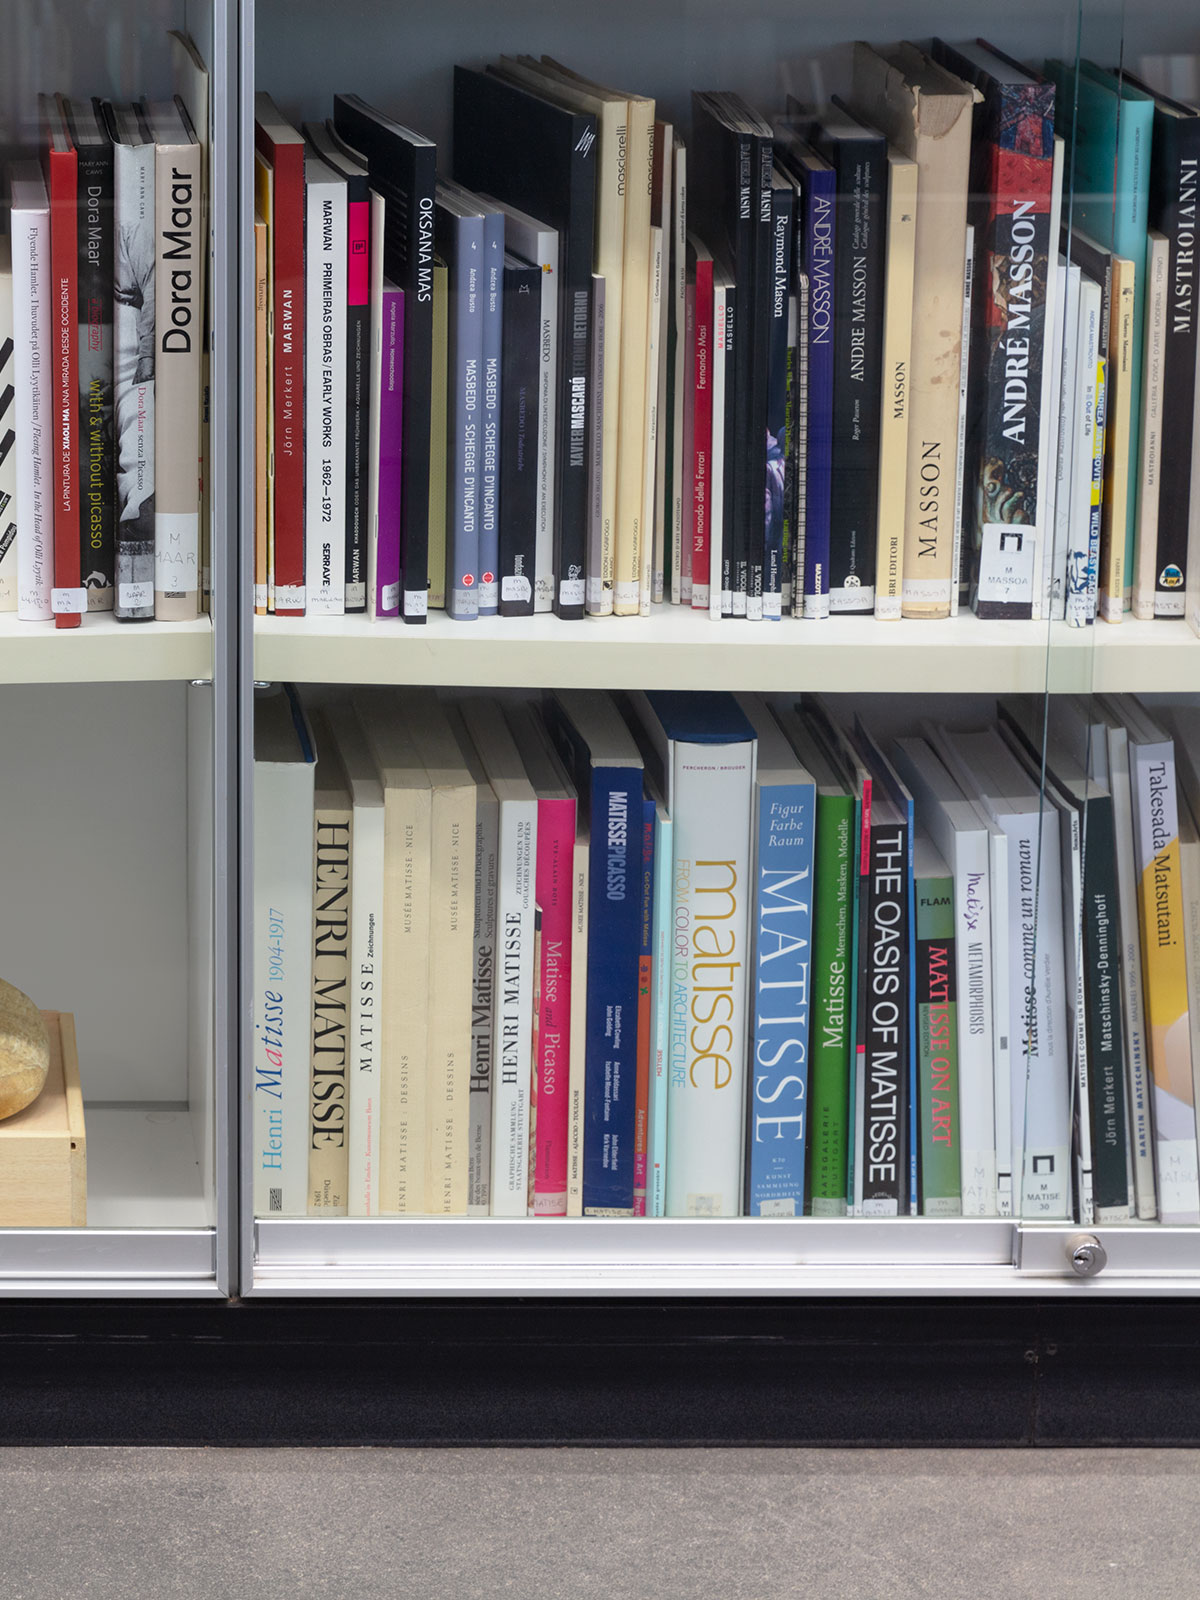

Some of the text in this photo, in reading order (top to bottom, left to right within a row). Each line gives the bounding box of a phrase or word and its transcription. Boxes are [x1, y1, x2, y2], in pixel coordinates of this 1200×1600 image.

[87, 186, 102, 265] Dora Maar
[163, 168, 191, 353] Dora Maar
[322, 262, 332, 323] PRIMEIRAS
[323, 200, 332, 251] MARWAN
[418, 198, 433, 301] OKSANA MAS
[469, 268, 477, 291] Andrea
[775, 215, 788, 318] Raymond Mason
[813, 197, 832, 344] ANDRÉ MASSON
[1174, 159, 1197, 333] MASTROIANNI
[282, 290, 292, 456] Jörn Merkert MARWAN
[322, 325, 332, 362] OBRAS
[322, 370, 332, 404] EARLY
[465, 360, 476, 410] MASBEDO
[851, 256, 867, 381] ANDRE MASSON
[894, 362, 905, 419] MASSON
[1000, 200, 1036, 445] ANDRÉ MASSON
[61, 278, 71, 511] LA PINTURA DE XIAOLI MA UNA MIRADA DESDE OCCIDENTE
[86, 380, 104, 549] with & without picasso
[137, 387, 146, 409] Dora
[137, 411, 146, 433] Maar
[322, 406, 332, 447] WORKS
[464, 424, 475, 473] SCHEGGE
[137, 460, 146, 490] Picasso
[464, 477, 475, 532] D'INCANTO
[918, 441, 941, 558] MASSON
[768, 835, 804, 847] Raum
[770, 803, 804, 817] Figur
[770, 818, 803, 831] Farbe
[1149, 762, 1177, 947] Takesada Matsutani
[312, 820, 349, 1150] HENRI MATISSE
[360, 913, 375, 1073] MATISSE Zeichnungen
[502, 913, 521, 1084] HENRI MATISSE
[672, 859, 690, 1087] FROM COLOR TO ARCHITECTURE
[690, 860, 741, 1089] matisse
[756, 865, 809, 1143] MATISSE
[822, 819, 849, 1048] Matisse Menschen, Masken, Modelle
[869, 831, 903, 1182] THE OASIS OF MATISSE
[964, 873, 985, 1034] Matisse METAMORPHOSES
[1018, 839, 1038, 1057] Matisse comme un roman
[255, 908, 285, 1171] Henri Matisse 1904-1917
[470, 946, 492, 1094] Henri Matisse
[544, 941, 561, 1095] Matisse and Picasso
[929, 947, 952, 1147] MATISSE ON ART
[1094, 894, 1116, 1146] Jörn Merkert Matschinsky-Denninghoff
